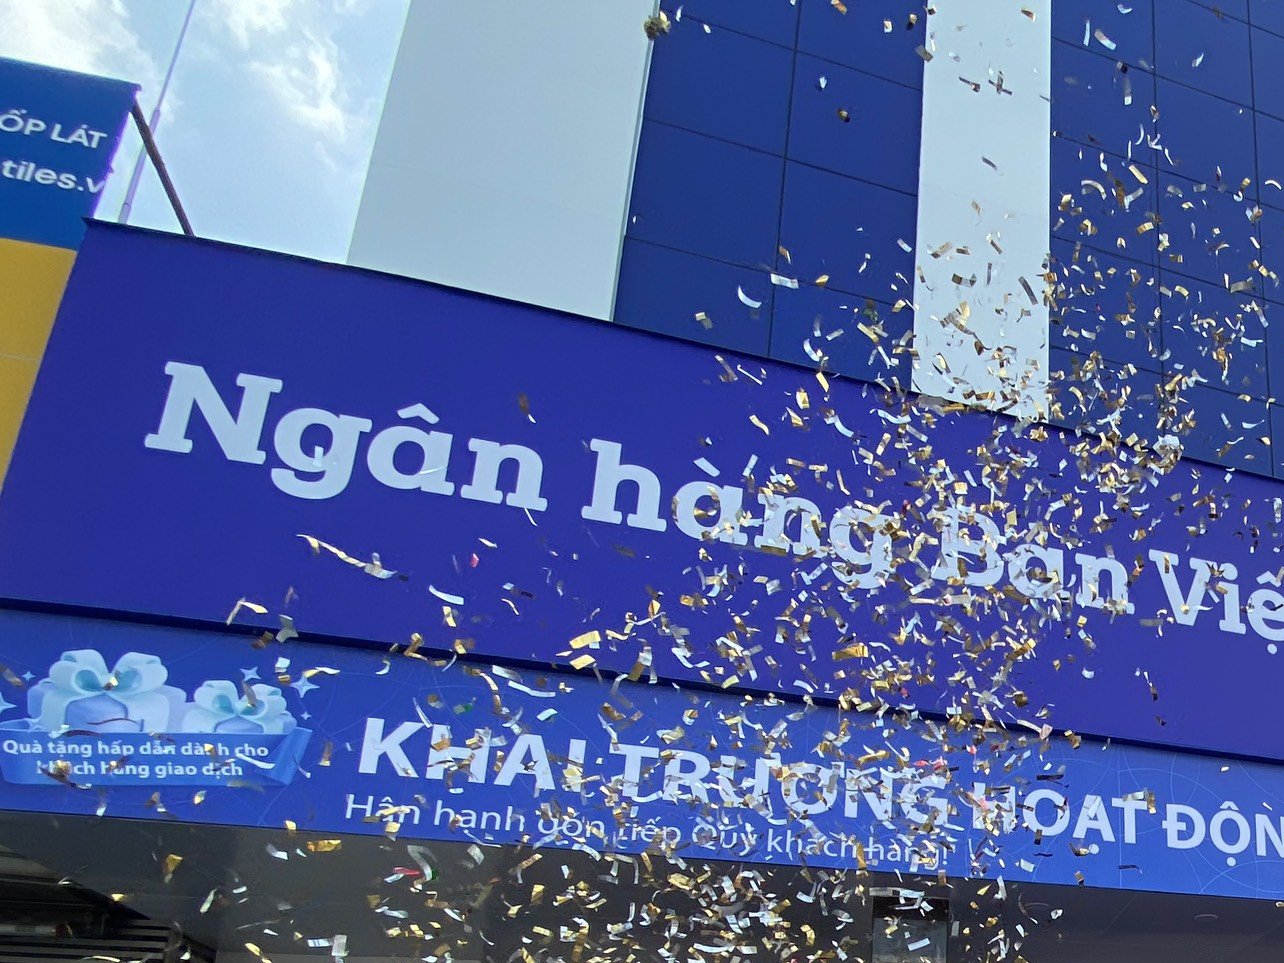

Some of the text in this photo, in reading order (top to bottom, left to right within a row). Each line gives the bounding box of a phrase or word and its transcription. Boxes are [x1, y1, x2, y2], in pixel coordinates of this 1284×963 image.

[50, 124, 108, 148] LÁT
[145, 361, 547, 511] Ngân
[581, 438, 900, 589] hàng
[3, 740, 42, 755] Quà
[48, 740, 92, 758] tặng
[98, 740, 134, 758] hấp
[140, 738, 176, 755] dẫn
[235, 743, 269, 757] cho
[155, 762, 197, 778] giao
[358, 717, 587, 792] KHAI
[972, 781, 1148, 855] HOẠT
